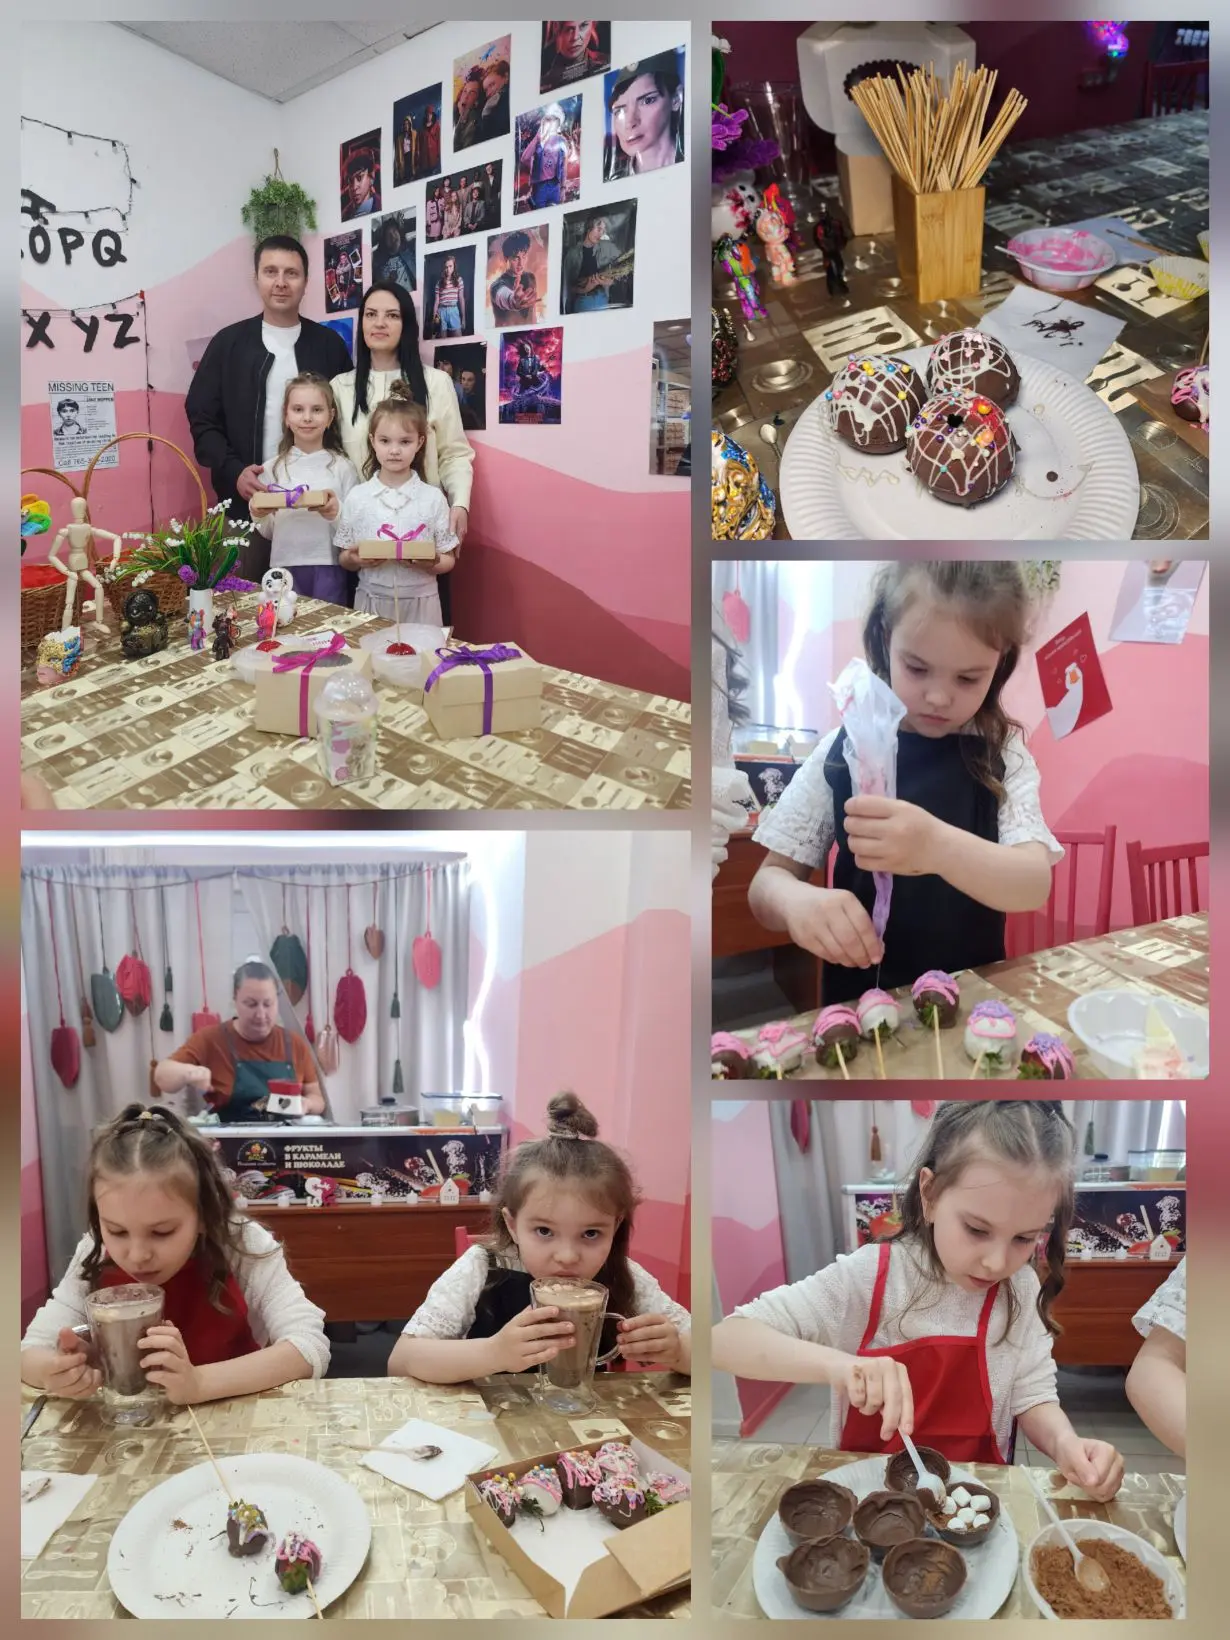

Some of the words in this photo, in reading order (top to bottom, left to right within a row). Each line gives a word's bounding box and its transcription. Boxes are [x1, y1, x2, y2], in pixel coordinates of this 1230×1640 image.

[48, 382, 89, 392] MISSING
[90, 382, 114, 392] TEEN
[284, 1144, 323, 1152] ФРУКТЫ
[285, 1161, 292, 1169] И
[293, 1161, 345, 1169] ШОКОЛАДЕ
